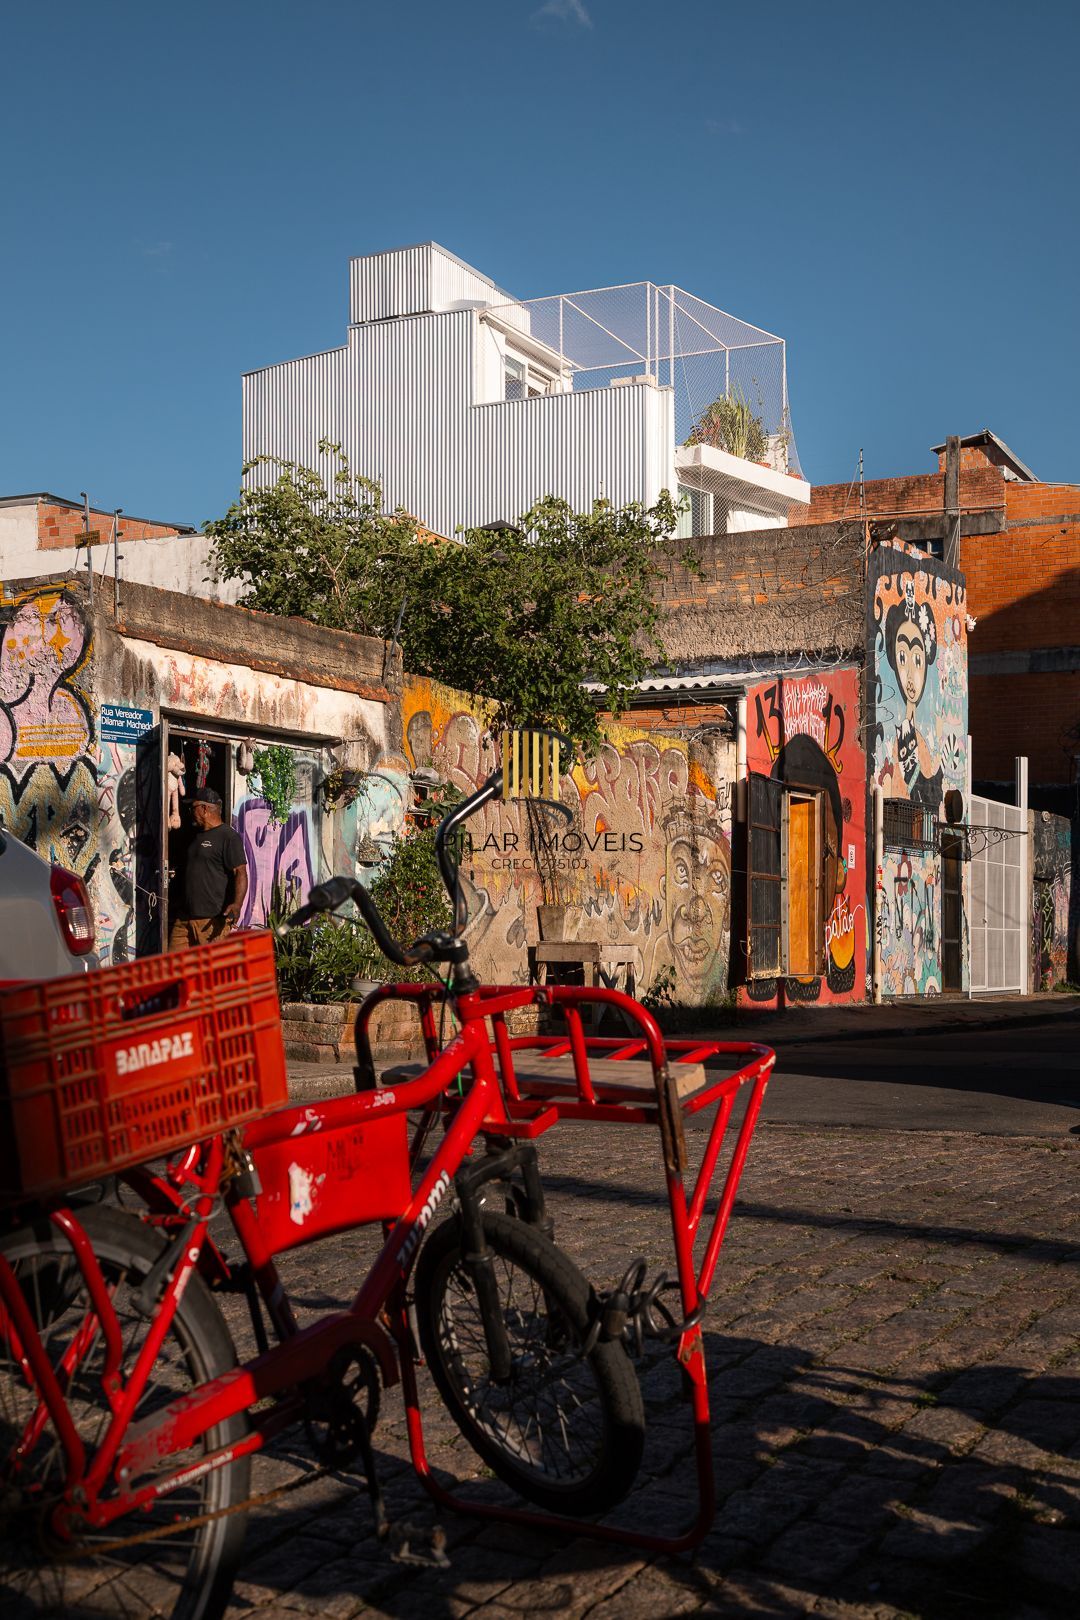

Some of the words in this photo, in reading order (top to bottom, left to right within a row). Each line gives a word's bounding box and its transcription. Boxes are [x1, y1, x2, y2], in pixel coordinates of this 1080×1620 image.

[101, 706, 114, 716] Rua
[115, 708, 144, 720] Vereador
[101, 716, 125, 727] Dilamar
[126, 720, 153, 730] Machado
[115, 1031, 195, 1076] BANAPAZ
